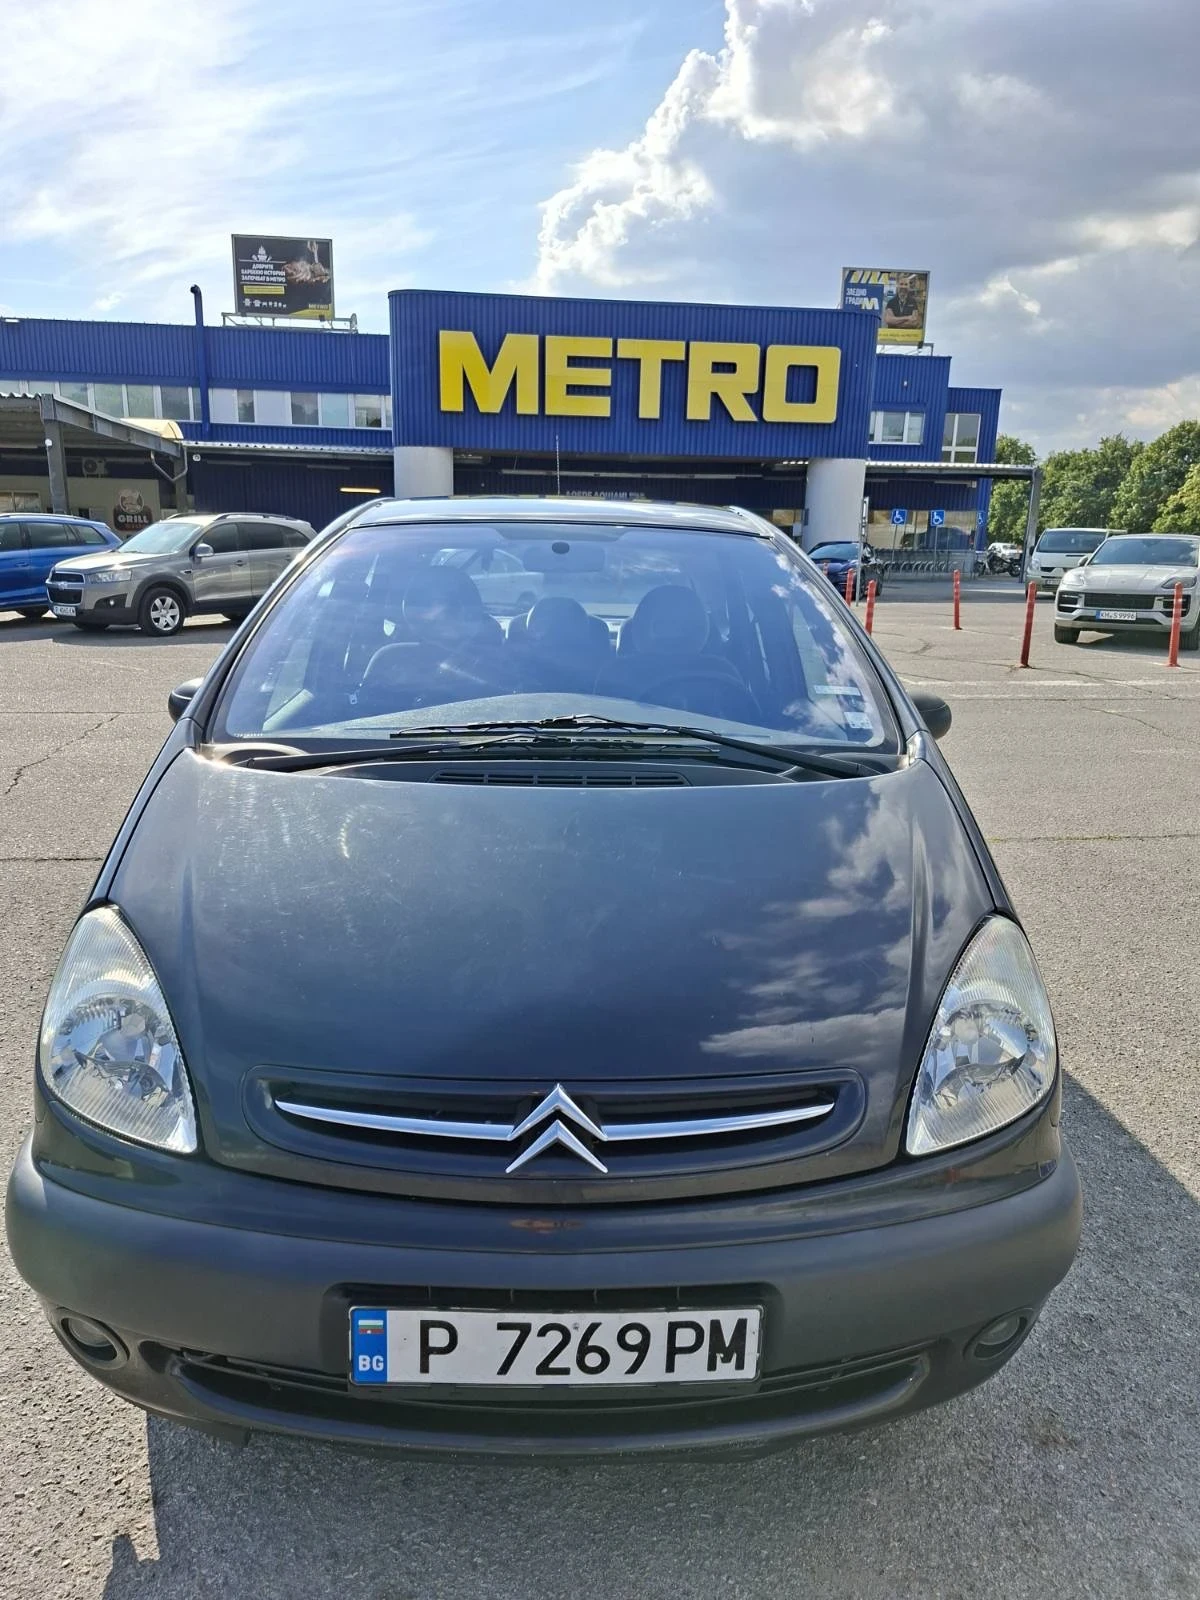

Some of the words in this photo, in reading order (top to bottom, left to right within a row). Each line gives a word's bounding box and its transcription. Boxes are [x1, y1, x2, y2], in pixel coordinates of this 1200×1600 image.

[439, 330, 842, 424] METRO
[117, 514, 148, 523] GRILL
[358, 1355, 384, 1372] BG
[419, 1319, 458, 1374] P
[496, 1321, 652, 1376] 7269
[664, 1317, 749, 1374] PM
